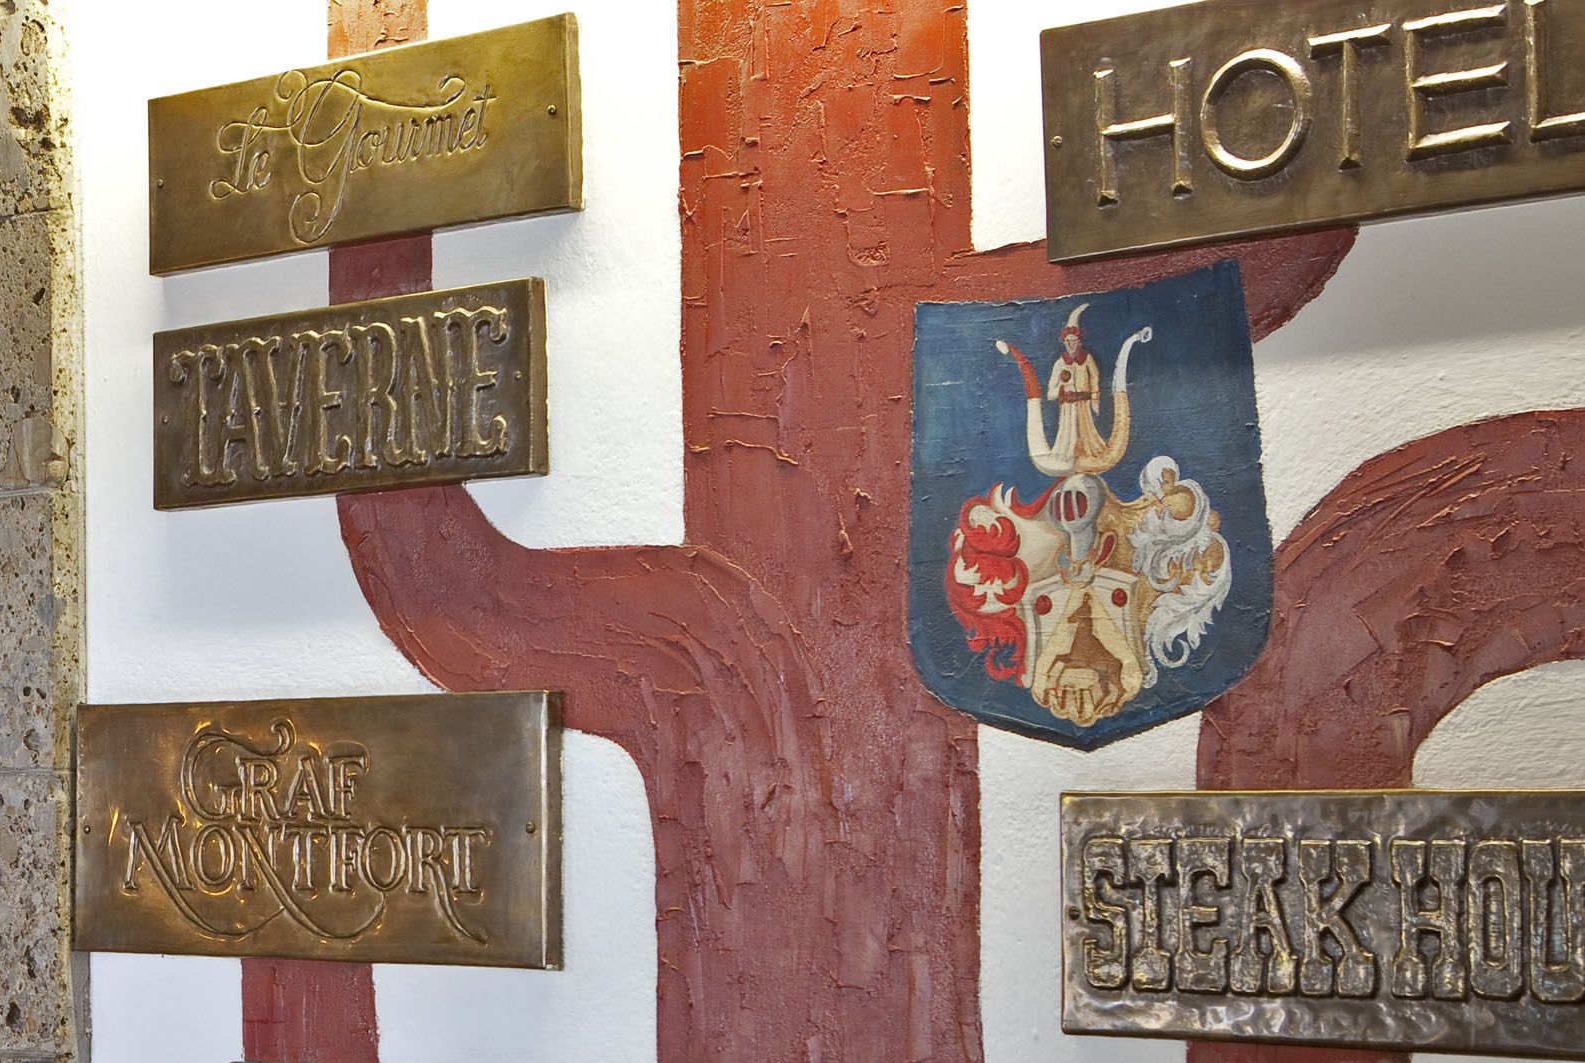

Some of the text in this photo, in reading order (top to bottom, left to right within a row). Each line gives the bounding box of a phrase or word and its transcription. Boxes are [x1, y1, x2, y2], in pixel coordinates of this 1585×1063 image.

[208, 69, 497, 244] Le Gourmet
[1092, 0, 1585, 208] HOTEL
[169, 305, 510, 489] TAVERNE
[179, 717, 371, 824] GRAF
[121, 814, 490, 945] MONTFORT
